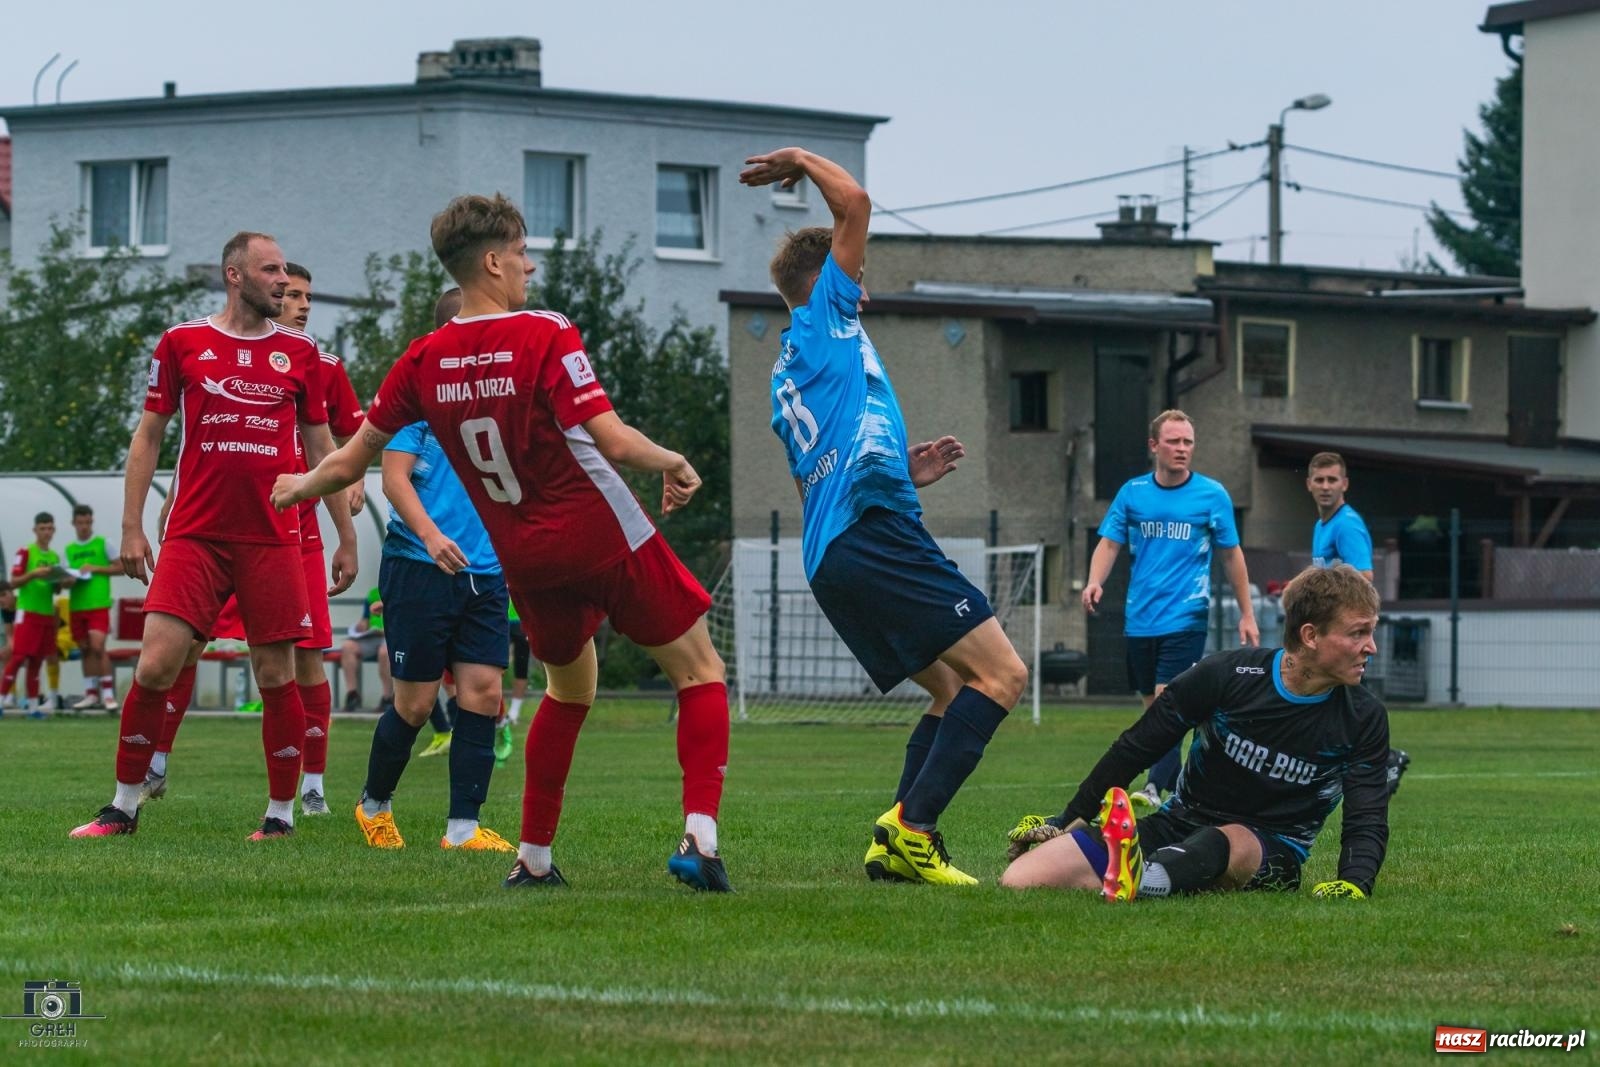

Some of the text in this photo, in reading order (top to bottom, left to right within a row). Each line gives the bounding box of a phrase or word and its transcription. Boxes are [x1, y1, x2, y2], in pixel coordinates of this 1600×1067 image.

[440, 351, 513, 369] GROS
[436, 377, 516, 403] UNIA TURZA
[201, 413, 240, 425] SACHS
[245, 415, 279, 428] TRANS
[217, 441, 278, 457] WENINGER
[459, 416, 523, 505] 9
[1140, 521, 1192, 540] DAR-BUD
[1224, 732, 1318, 785] DAR-BUD
